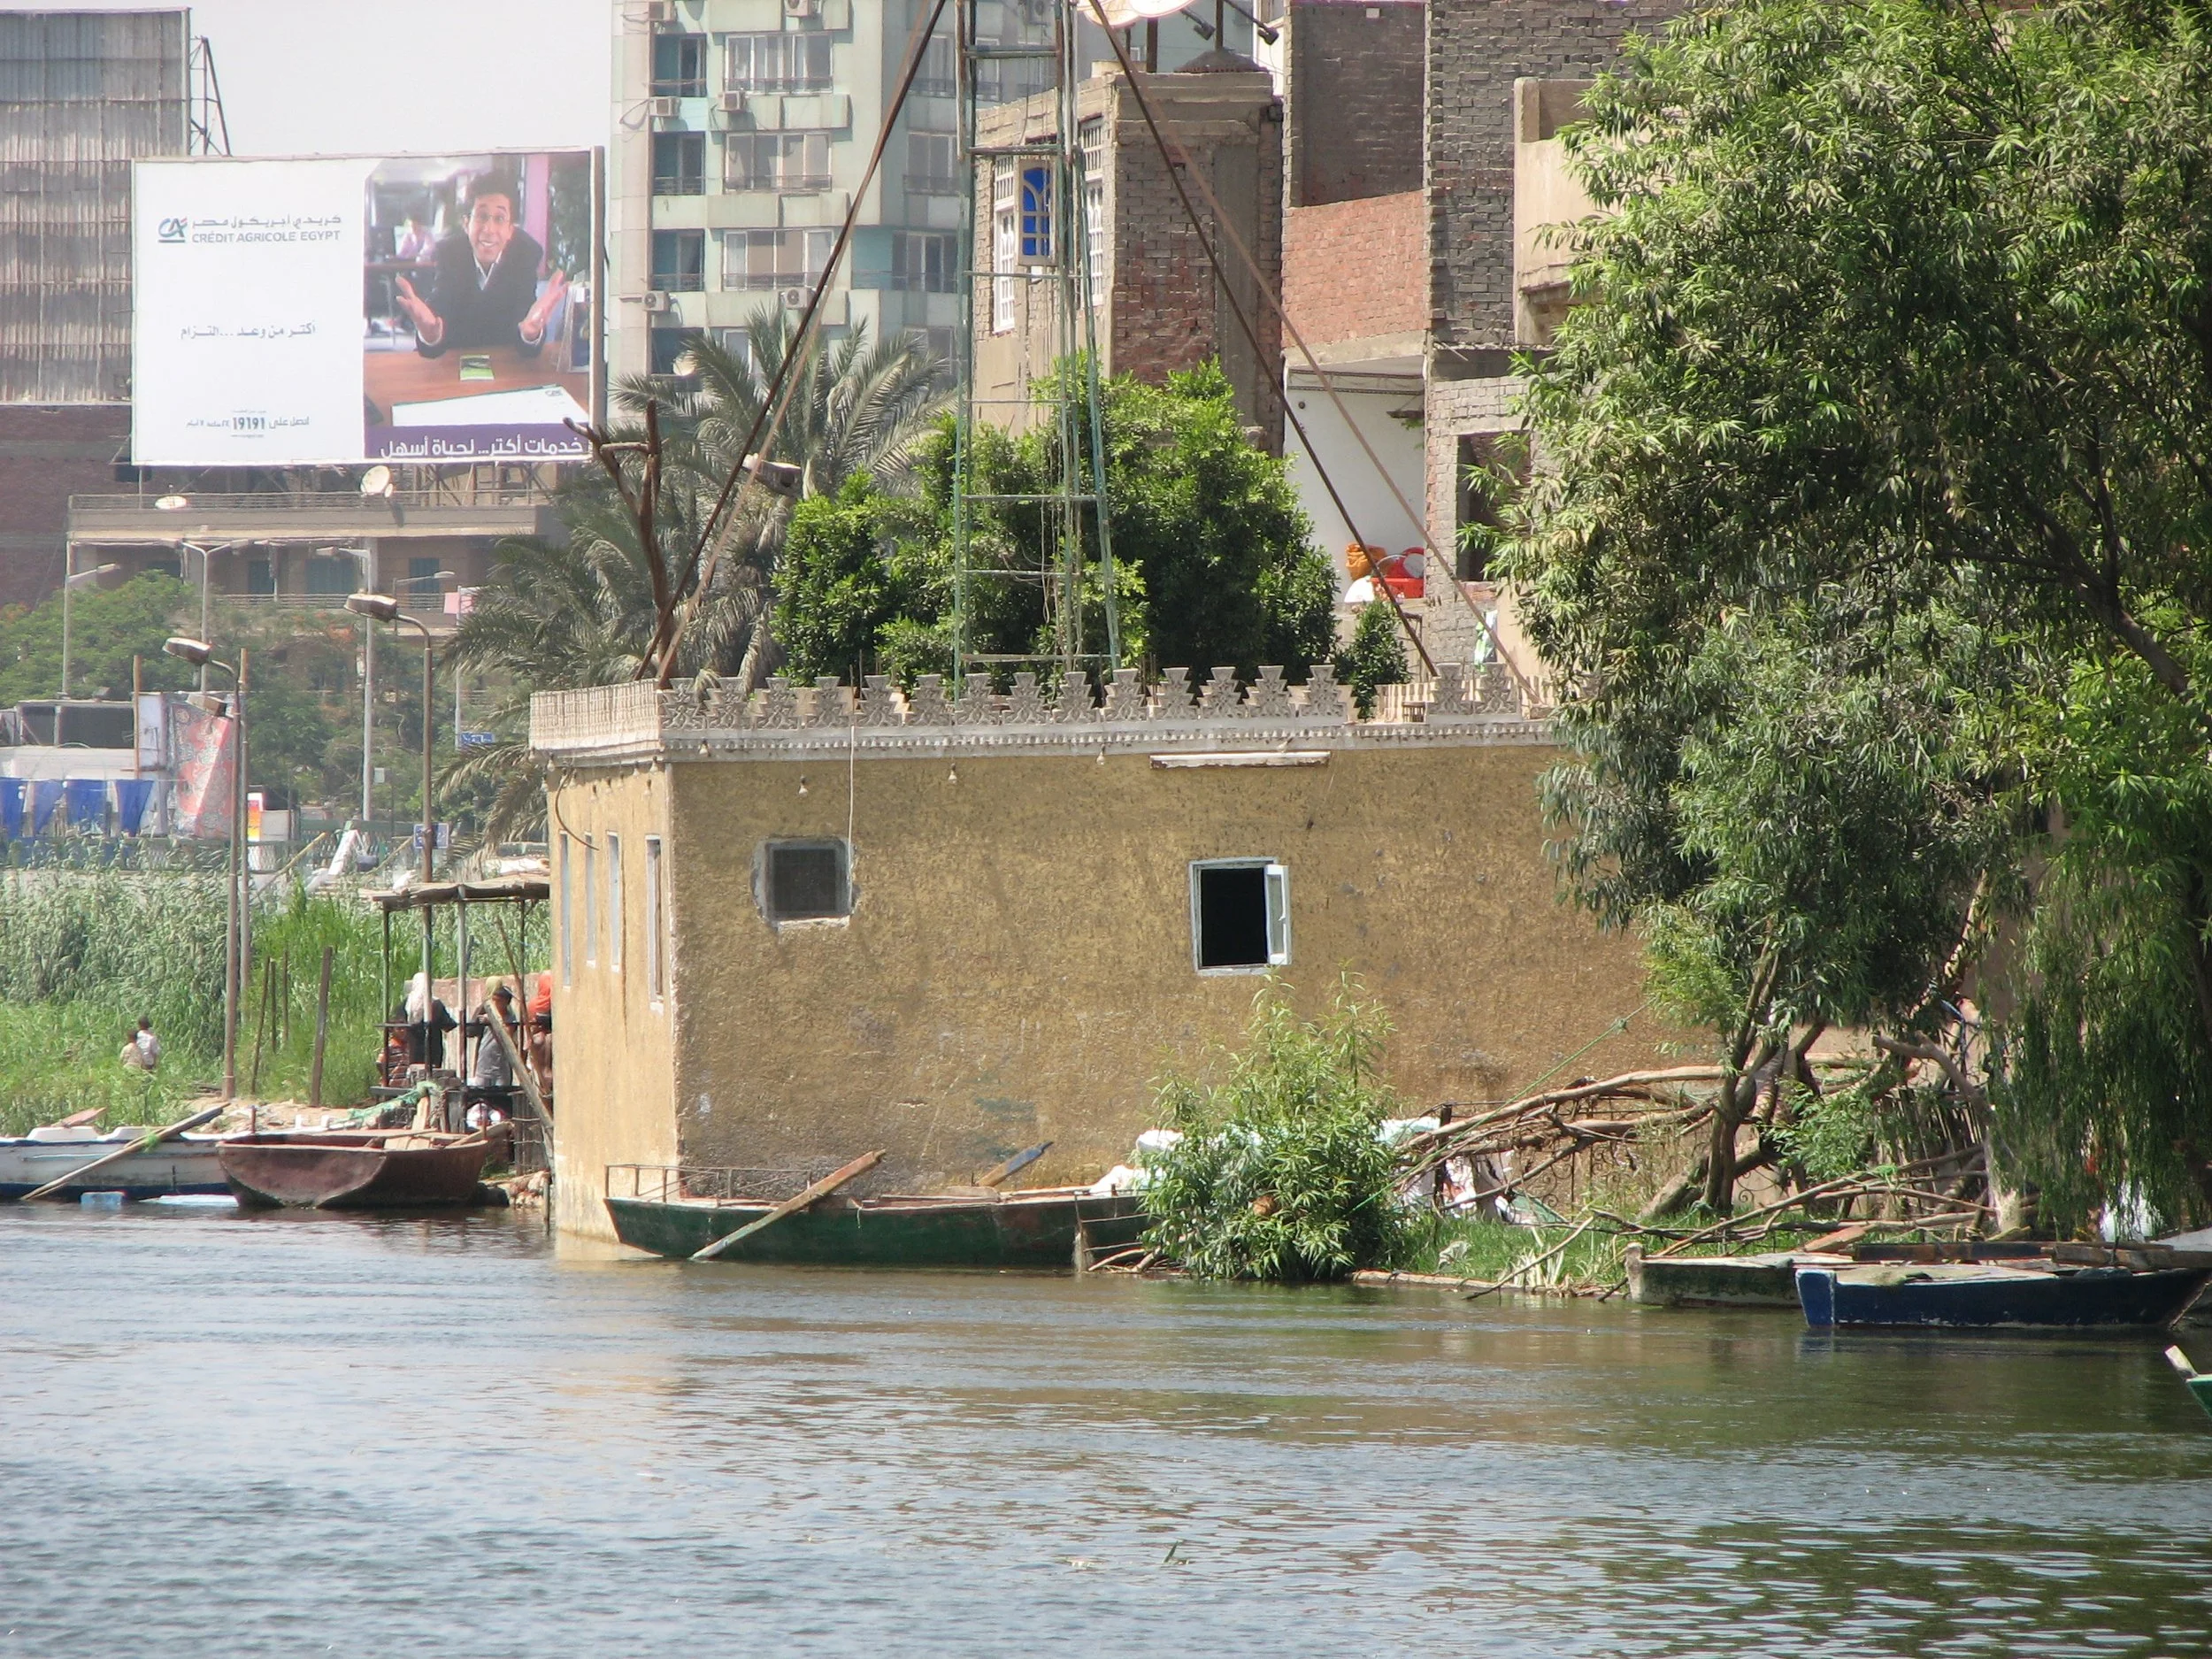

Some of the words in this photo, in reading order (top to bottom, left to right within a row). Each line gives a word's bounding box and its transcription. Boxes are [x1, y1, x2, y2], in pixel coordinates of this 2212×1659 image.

[191, 219, 228, 229] مصر
[192, 230, 234, 243] CRÉDIT
[236, 231, 296, 242] AGRICOLE
[300, 230, 341, 241] EGYPT
[235, 326, 265, 339] وعد
[268, 325, 284, 339] من
[233, 417, 265, 430] 19191
[268, 417, 289, 429] على
[380, 435, 429, 459] أسهل
[432, 438, 475, 459] لحياة
[524, 436, 584, 455] خدمات
